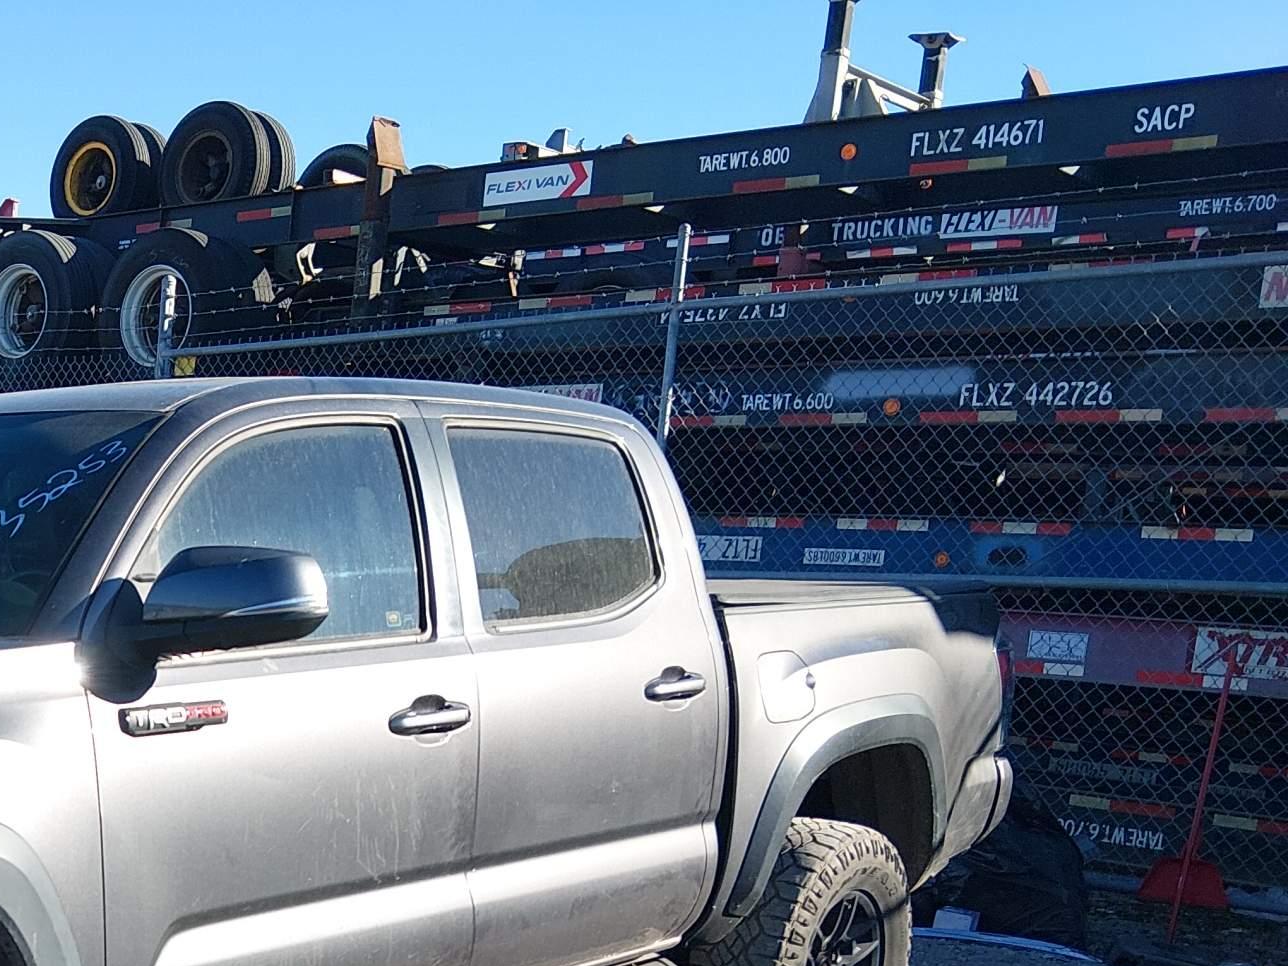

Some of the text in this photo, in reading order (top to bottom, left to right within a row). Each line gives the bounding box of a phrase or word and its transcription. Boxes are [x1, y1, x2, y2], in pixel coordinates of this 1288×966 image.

[1134, 103, 1194, 133] SACP
[910, 119, 1044, 157] FLXZ 414671
[486, 174, 570, 195] FLEXI VAN
[831, 215, 933, 241] TRUCKING
[959, 381, 1113, 407] FLXZ 442726
